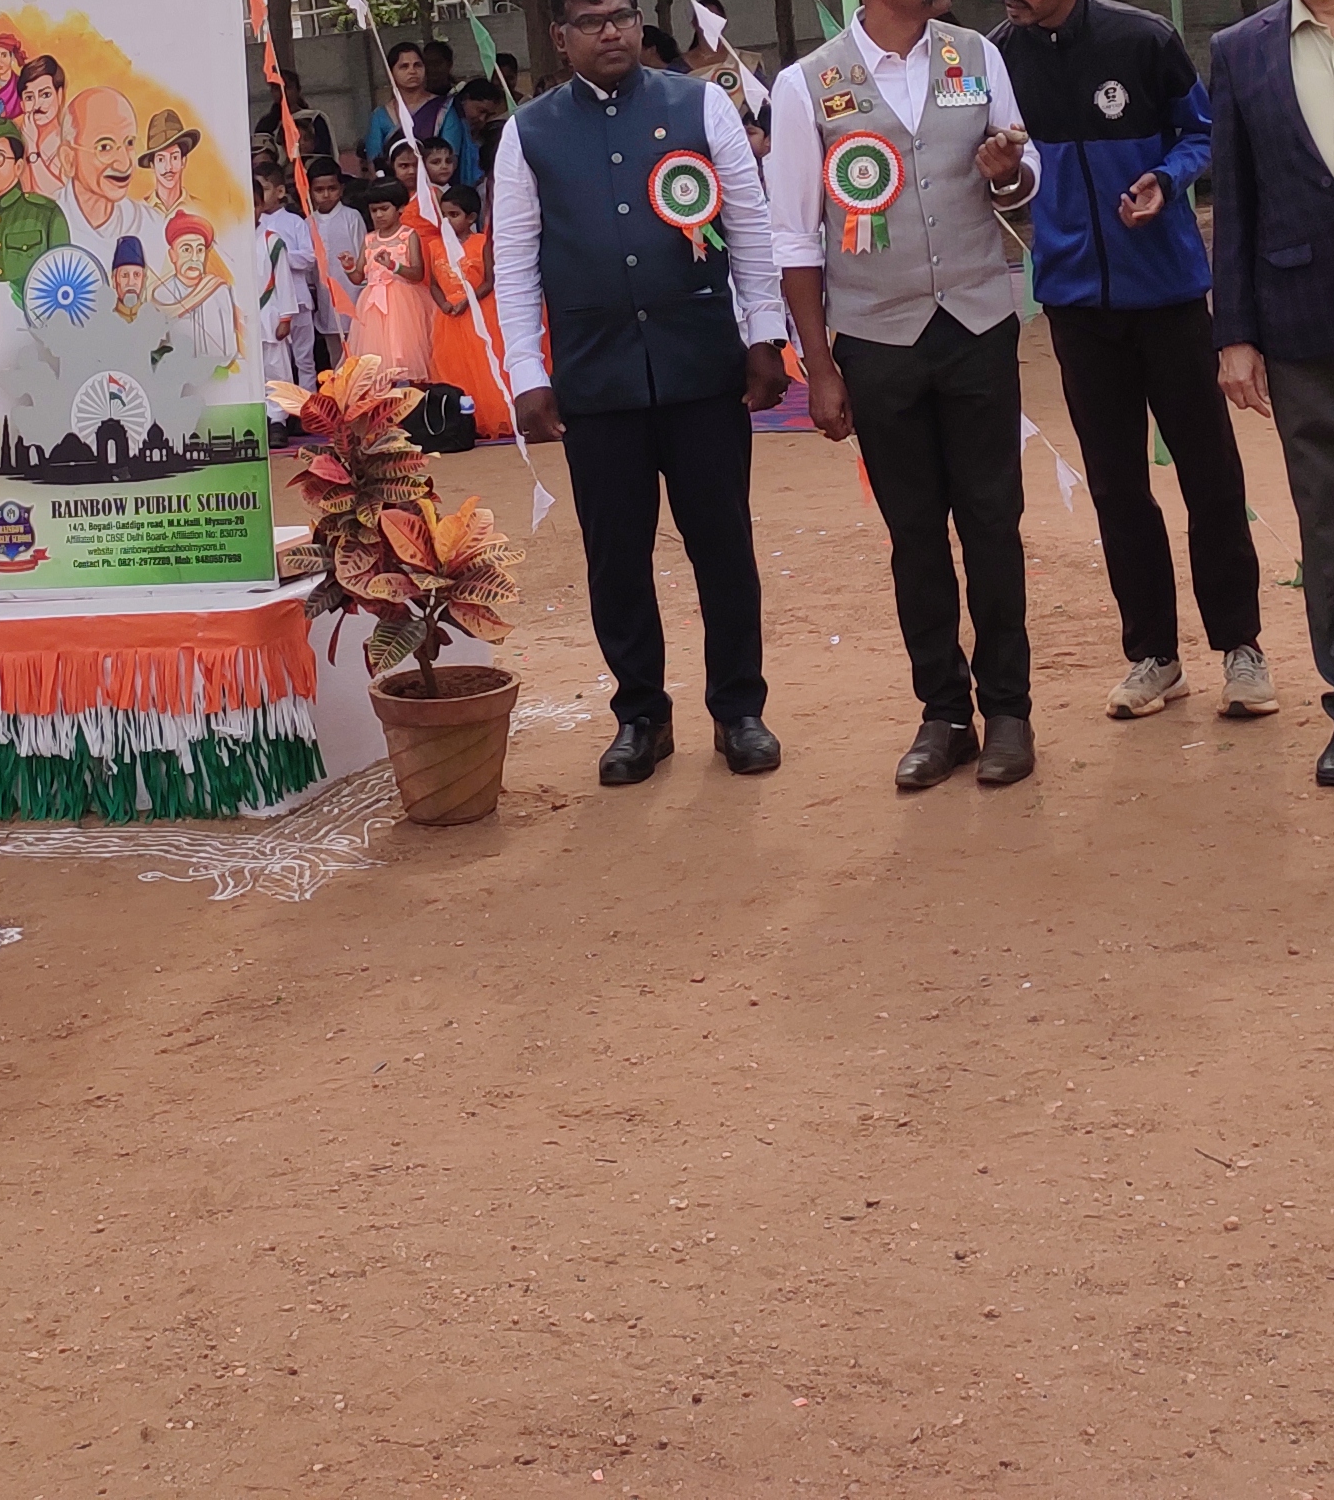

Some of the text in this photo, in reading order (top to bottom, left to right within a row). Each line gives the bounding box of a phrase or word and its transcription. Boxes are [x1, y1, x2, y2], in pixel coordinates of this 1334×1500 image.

[51, 491, 261, 518] RAINBOW PUBLIC SCHOOL
[97, 535, 104, 543] to
[105, 533, 125, 543] CBSE
[127, 532, 144, 542] Delhi
